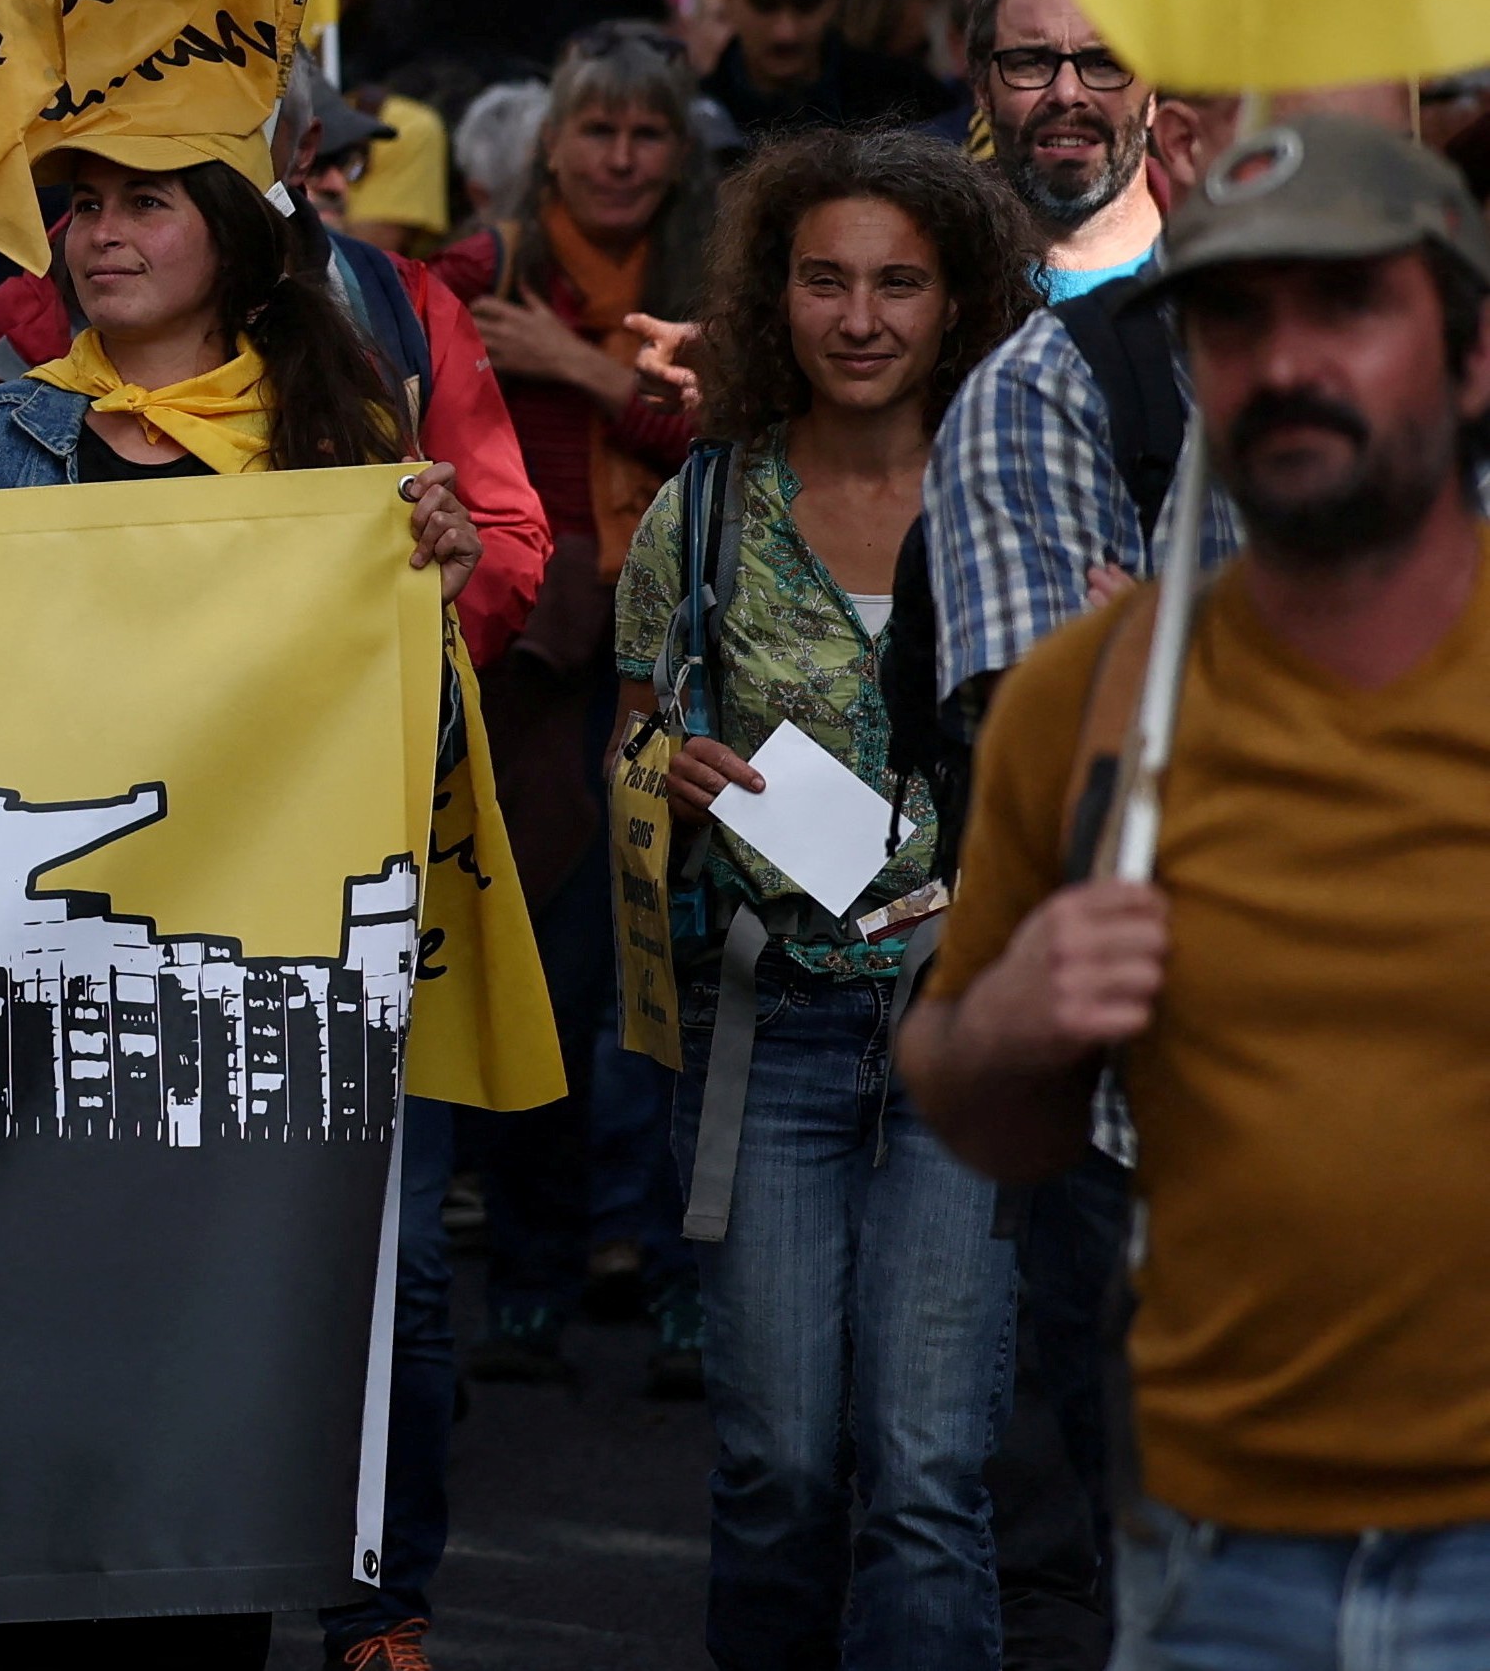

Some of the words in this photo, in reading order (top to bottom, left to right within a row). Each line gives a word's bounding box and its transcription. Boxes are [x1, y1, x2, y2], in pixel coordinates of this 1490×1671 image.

[623, 759, 643, 789] Pas
[641, 764, 656, 795] de
[628, 816, 656, 850] sans
